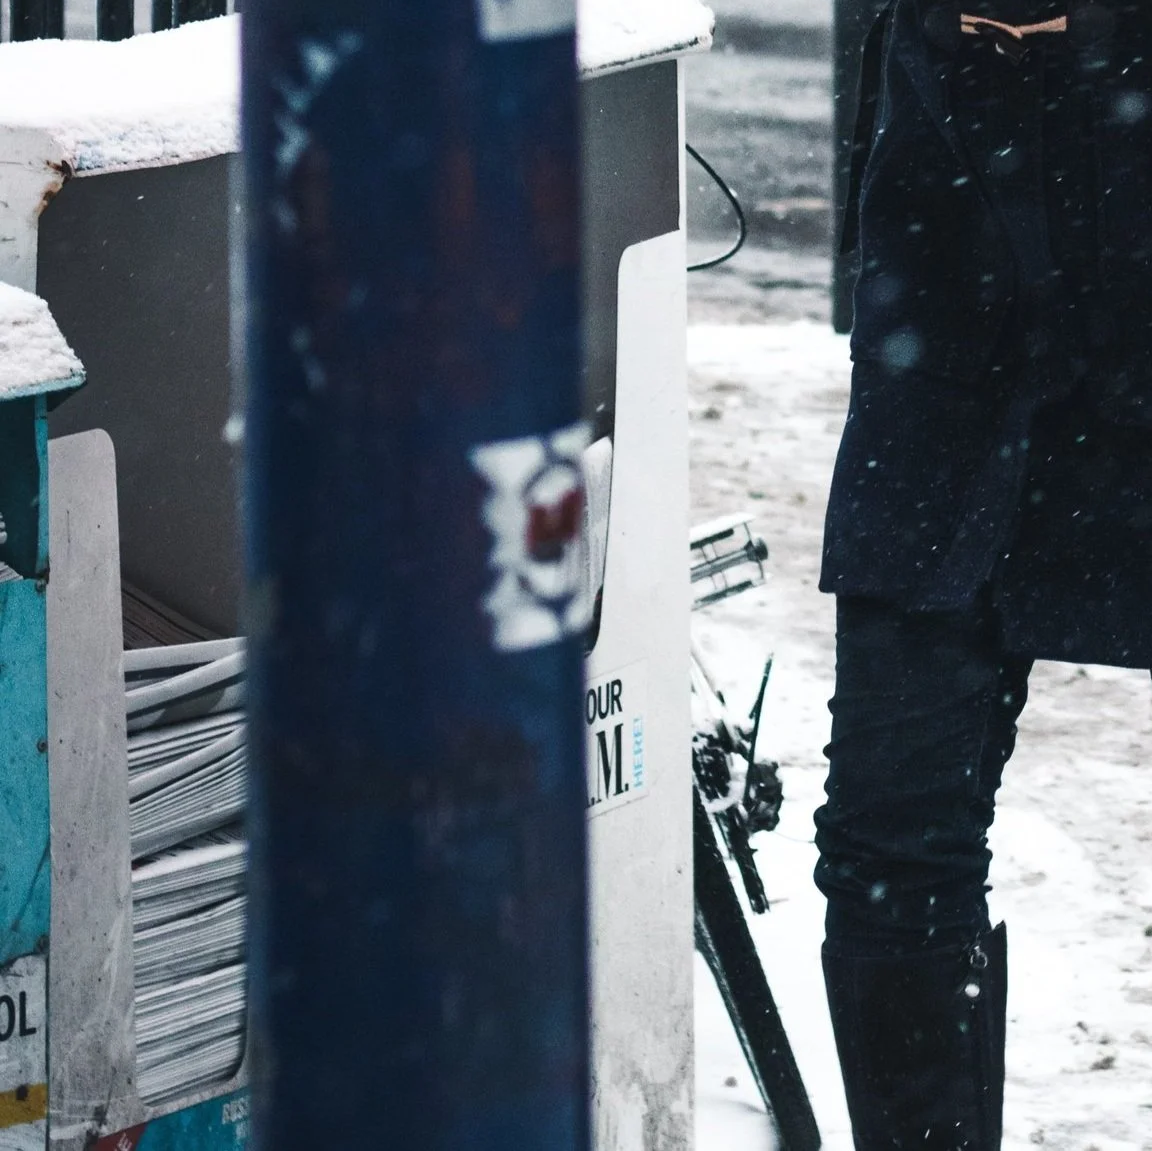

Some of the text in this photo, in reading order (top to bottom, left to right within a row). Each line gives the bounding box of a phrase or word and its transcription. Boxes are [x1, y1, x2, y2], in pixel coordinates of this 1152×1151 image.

[586, 679, 623, 726] OUR
[585, 723, 629, 809] .M.
[0, 991, 37, 1042] OL
